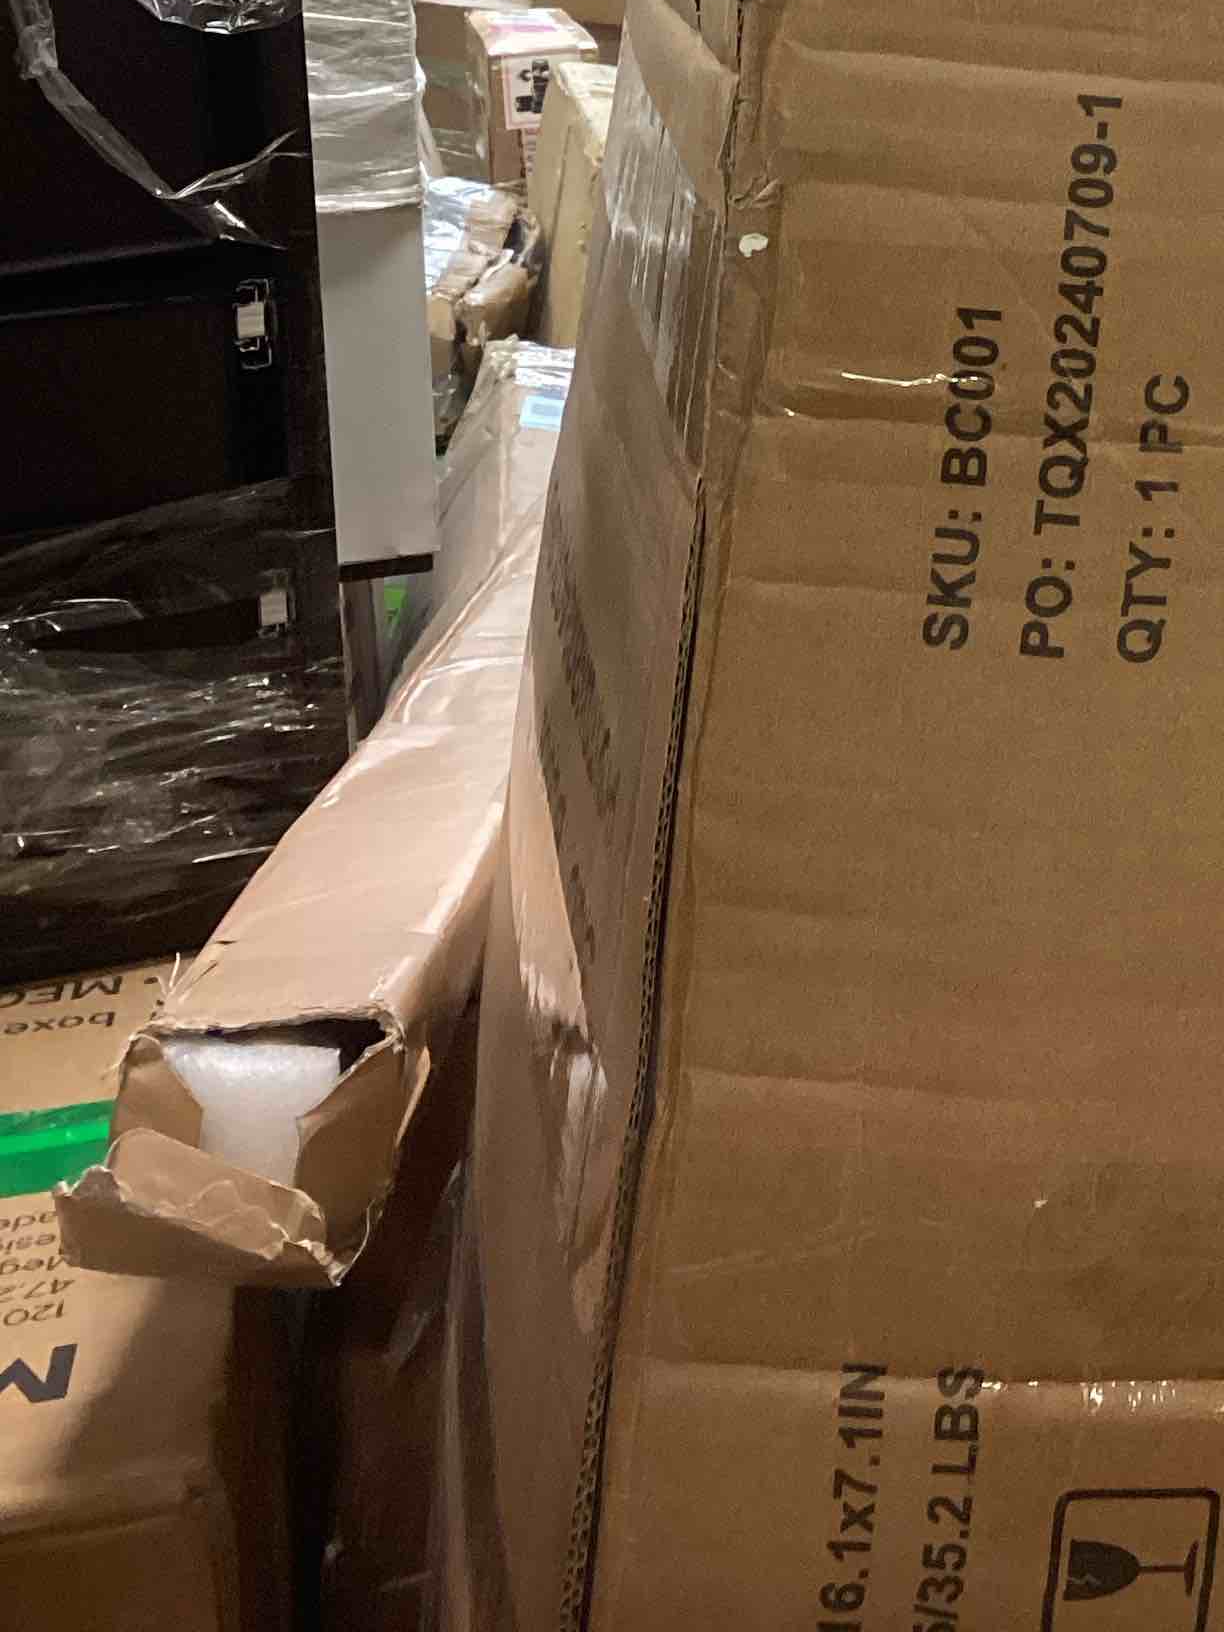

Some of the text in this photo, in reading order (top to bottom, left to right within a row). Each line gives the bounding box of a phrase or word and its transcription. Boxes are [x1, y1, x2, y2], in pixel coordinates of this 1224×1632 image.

[922, 306, 1003, 651] SKU: BC001
[1018, 94, 1123, 659] PO: TQX20240709-1
[1116, 373, 1190, 664] QTY: 1 PC
[930, 1365, 985, 1476] LBS
